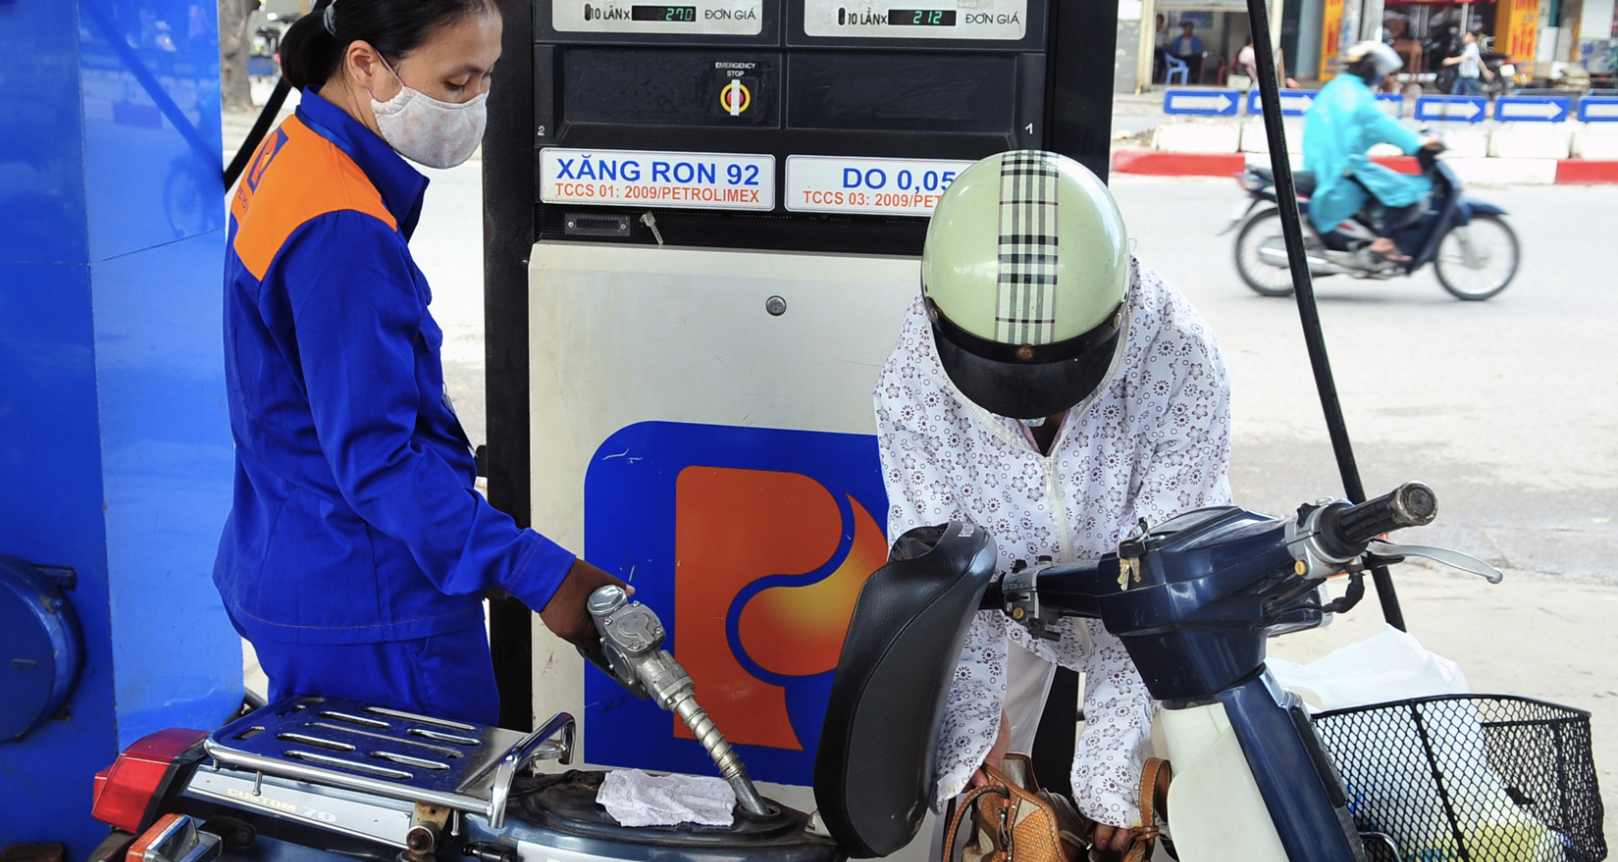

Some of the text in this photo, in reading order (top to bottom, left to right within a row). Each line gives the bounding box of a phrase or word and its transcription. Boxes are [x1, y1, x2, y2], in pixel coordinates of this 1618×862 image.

[704, 8, 756, 20] ĐƠN GIÁ
[848, 13, 858, 25] 10
[913, 10, 942, 24] 212
[965, 11, 1020, 25] ĐƠN GIÁ
[715, 61, 756, 69] EMERGENCY
[537, 125, 546, 136] 2
[1025, 122, 1033, 135] 1
[556, 154, 760, 186] XĂNG RON 92
[843, 167, 887, 190] DO
[555, 182, 760, 203] TCCS 01: 2009/PETROLIMEX
[803, 190, 844, 205] TCCS
[848, 192, 870, 206] 03:
[227, 788, 337, 823] CUSTOM 70
